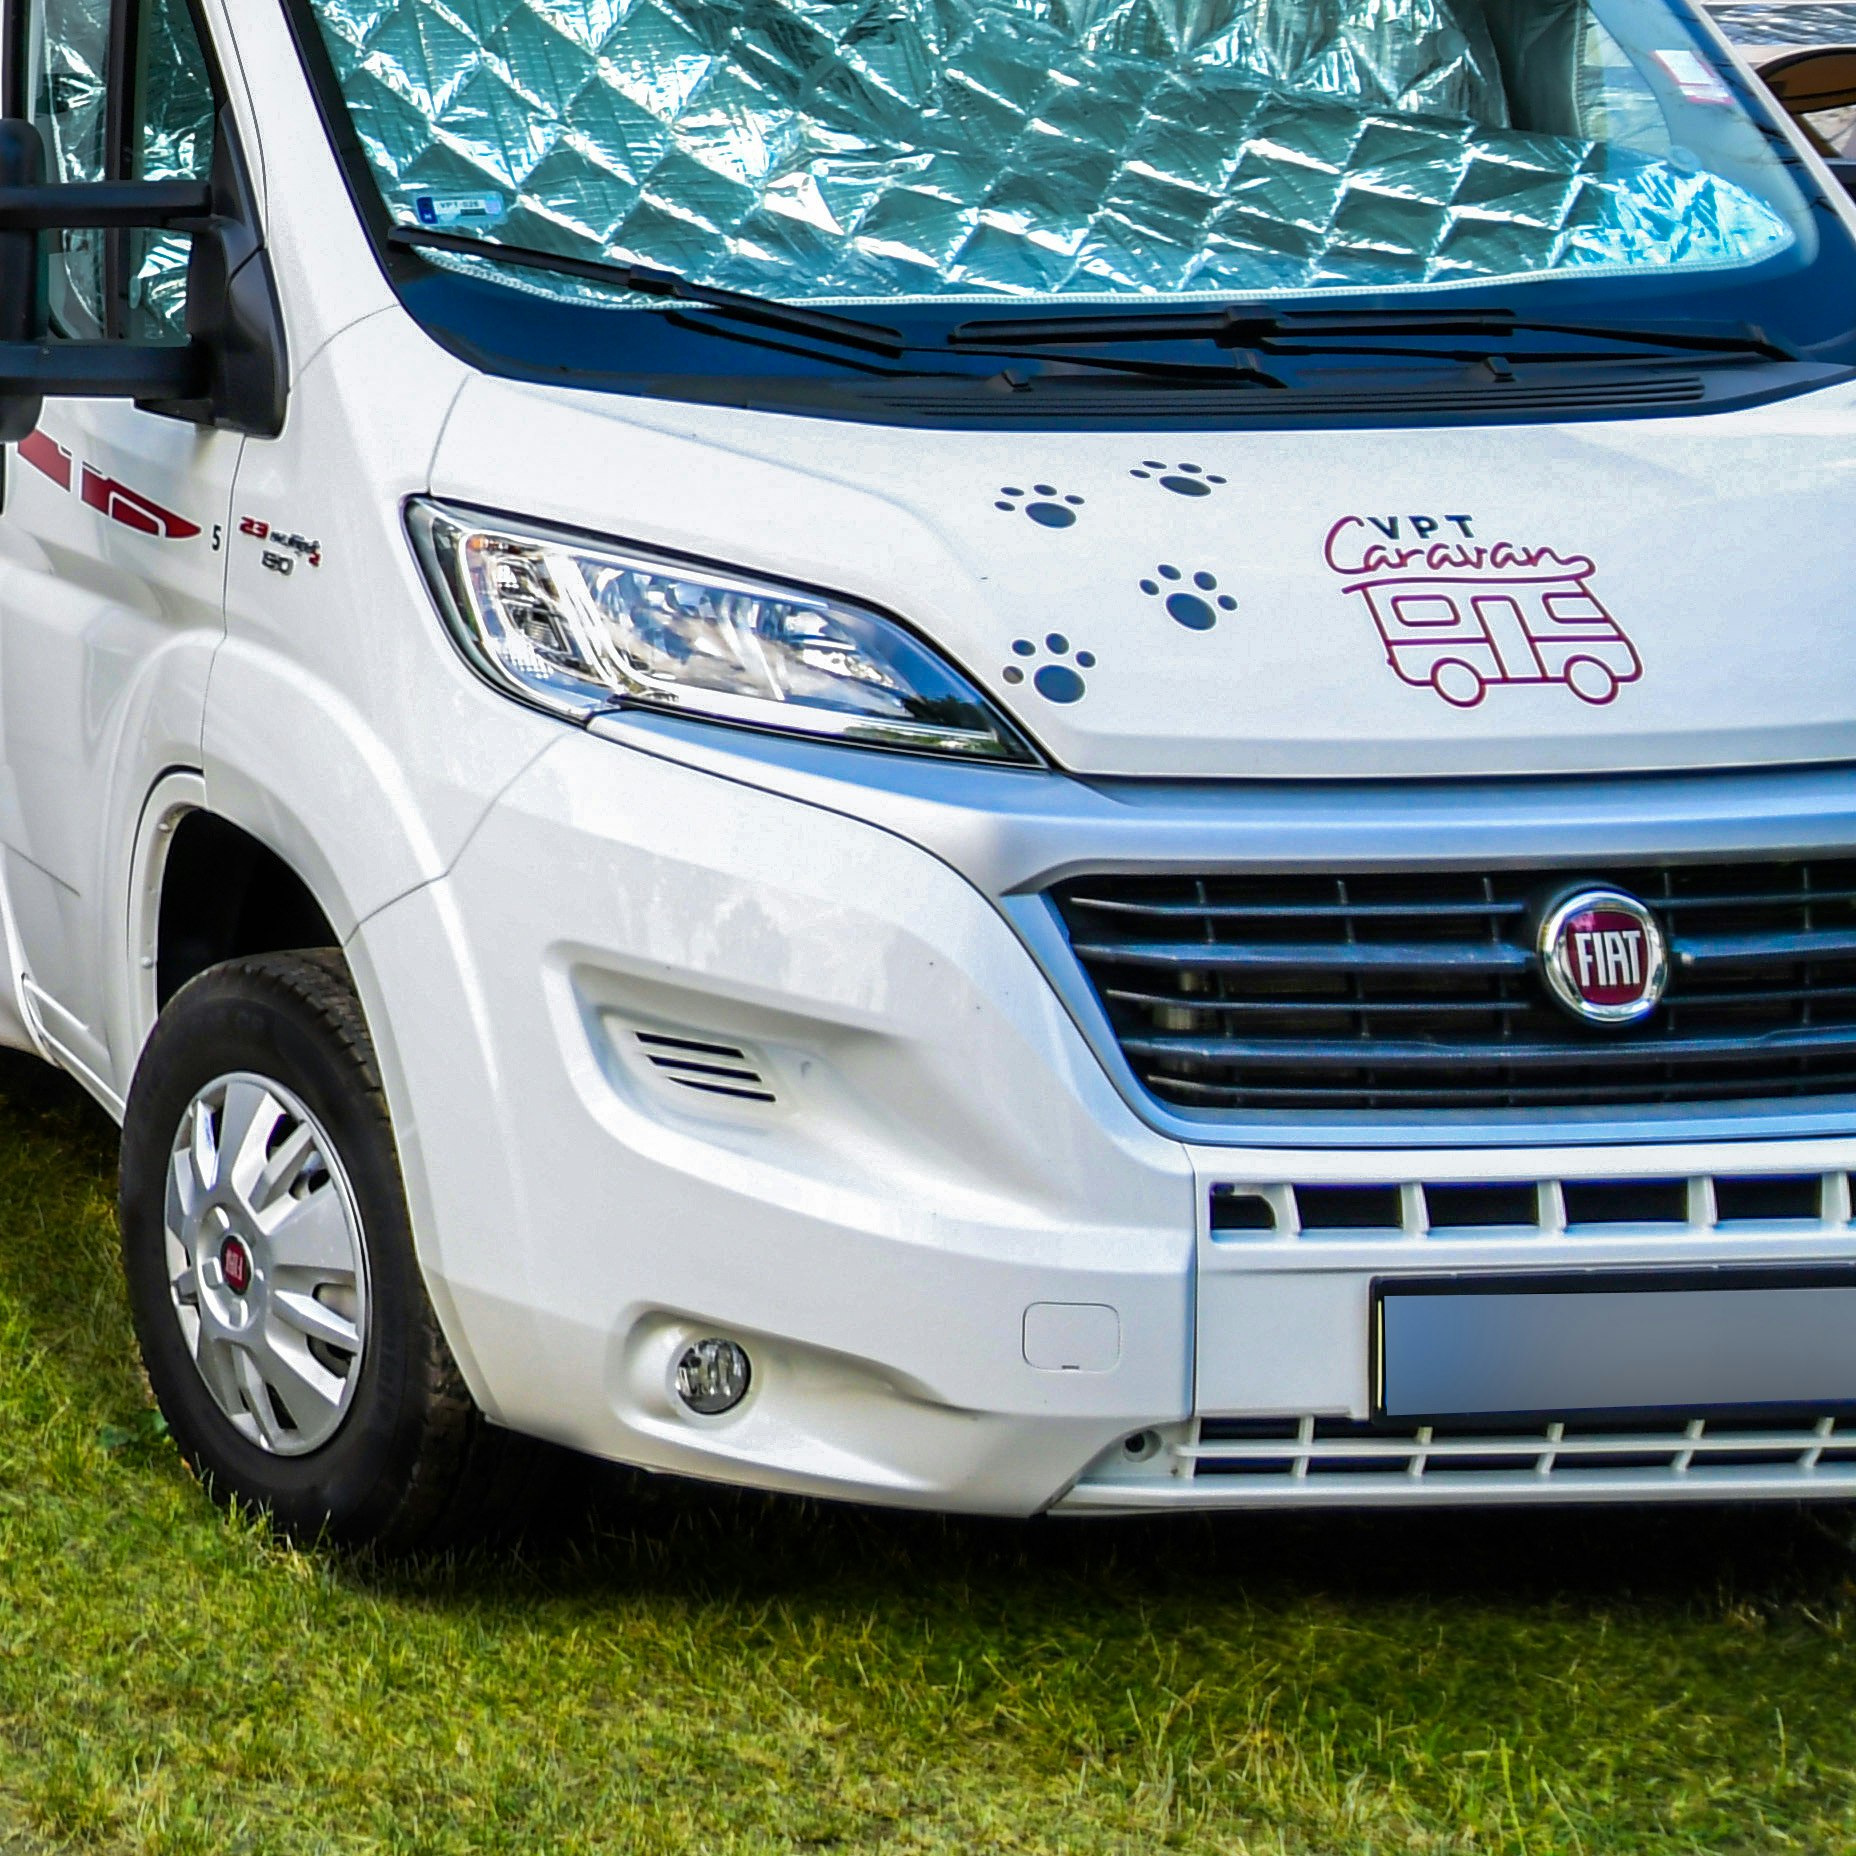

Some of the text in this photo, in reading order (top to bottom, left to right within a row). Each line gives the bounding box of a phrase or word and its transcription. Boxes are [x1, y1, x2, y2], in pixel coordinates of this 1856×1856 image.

[211, 524, 222, 551] 5
[1324, 515, 1596, 575] Caravan
[1366, 514, 1475, 540] VPT
[1574, 930, 1641, 987] FIAT
